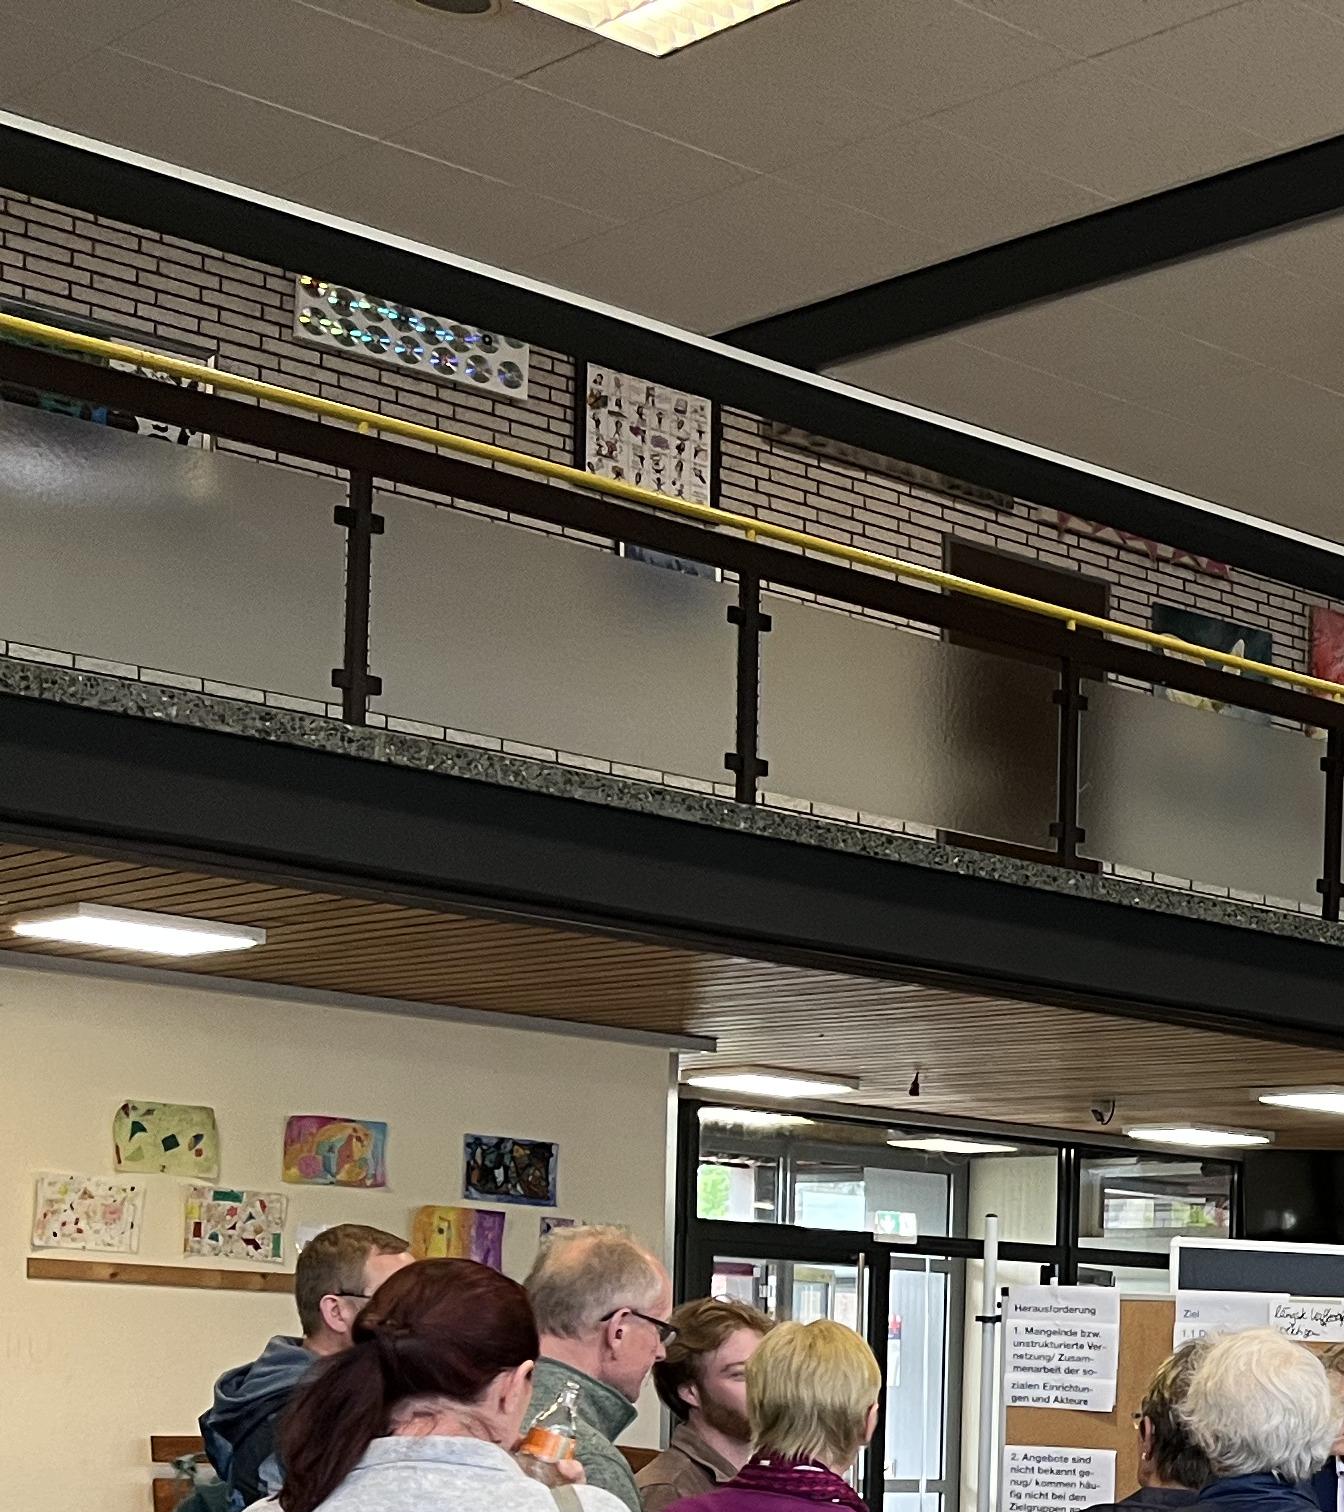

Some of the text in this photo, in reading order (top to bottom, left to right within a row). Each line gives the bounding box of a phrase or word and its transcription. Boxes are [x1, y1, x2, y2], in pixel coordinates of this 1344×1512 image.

[1014, 1304, 1097, 1316] Herausforderung
[1183, 1309, 1200, 1318] Ziel
[1024, 1326, 1078, 1337] Mangelnde
[1012, 1340, 1085, 1350] unstrukturierte
[1012, 1365, 1061, 1374] menarbeit
[1063, 1366, 1080, 1375] der
[1011, 1382, 1039, 1390] zialen
[1011, 1395, 1088, 1405] gen und Akteure
[1022, 1453, 1069, 1463] Angebote
[1071, 1456, 1092, 1464] sind
[1010, 1465, 1035, 1474] nicht
[1037, 1466, 1077, 1476] bekannt
[1034, 1479, 1077, 1488] kommen
[1009, 1490, 1087, 1501] fig nicht bei den
